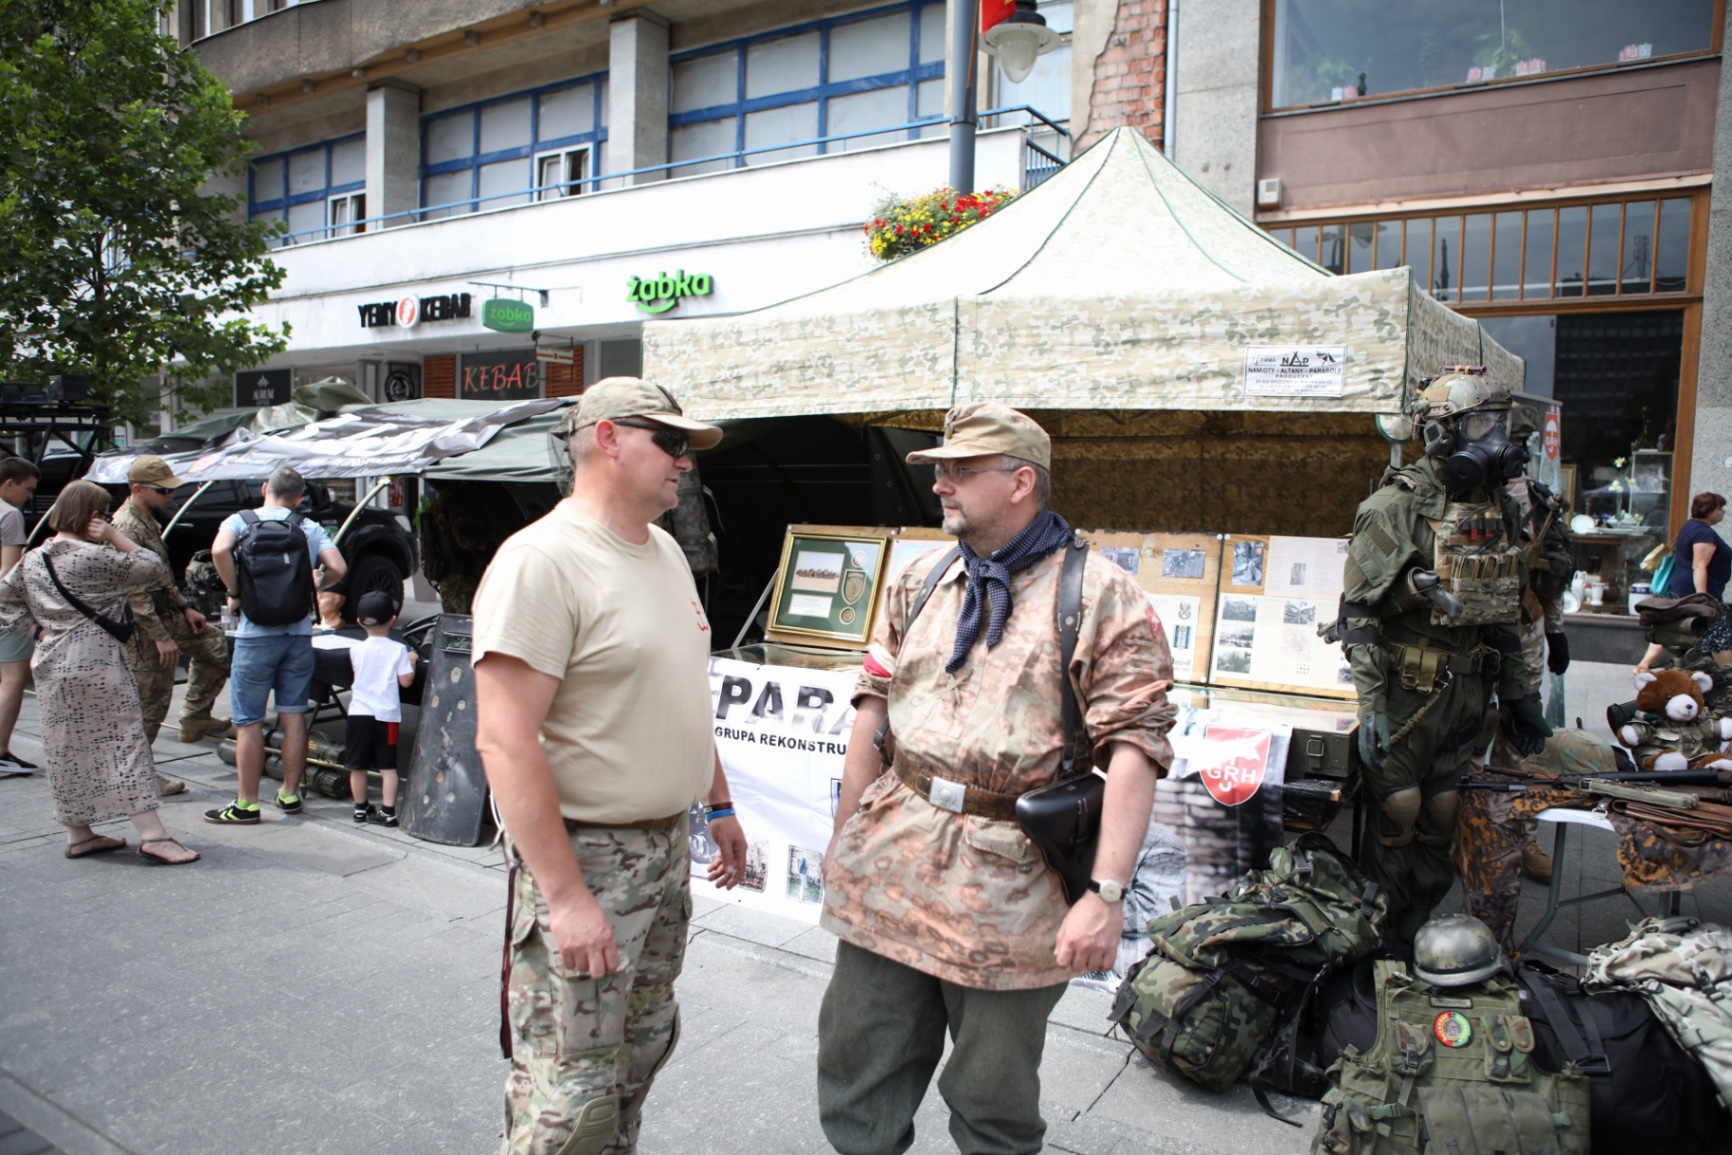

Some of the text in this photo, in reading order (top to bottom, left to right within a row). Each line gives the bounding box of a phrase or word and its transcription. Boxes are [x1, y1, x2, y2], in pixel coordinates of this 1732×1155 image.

[626, 268, 713, 304] żabka
[420, 293, 472, 322] KEBAB
[490, 304, 532, 323] żabka
[1281, 351, 1309, 366] NAP
[464, 362, 539, 392] KEBAB
[714, 726, 847, 756] GRUPA REKONSTRU
[1206, 764, 1257, 785] GRH
